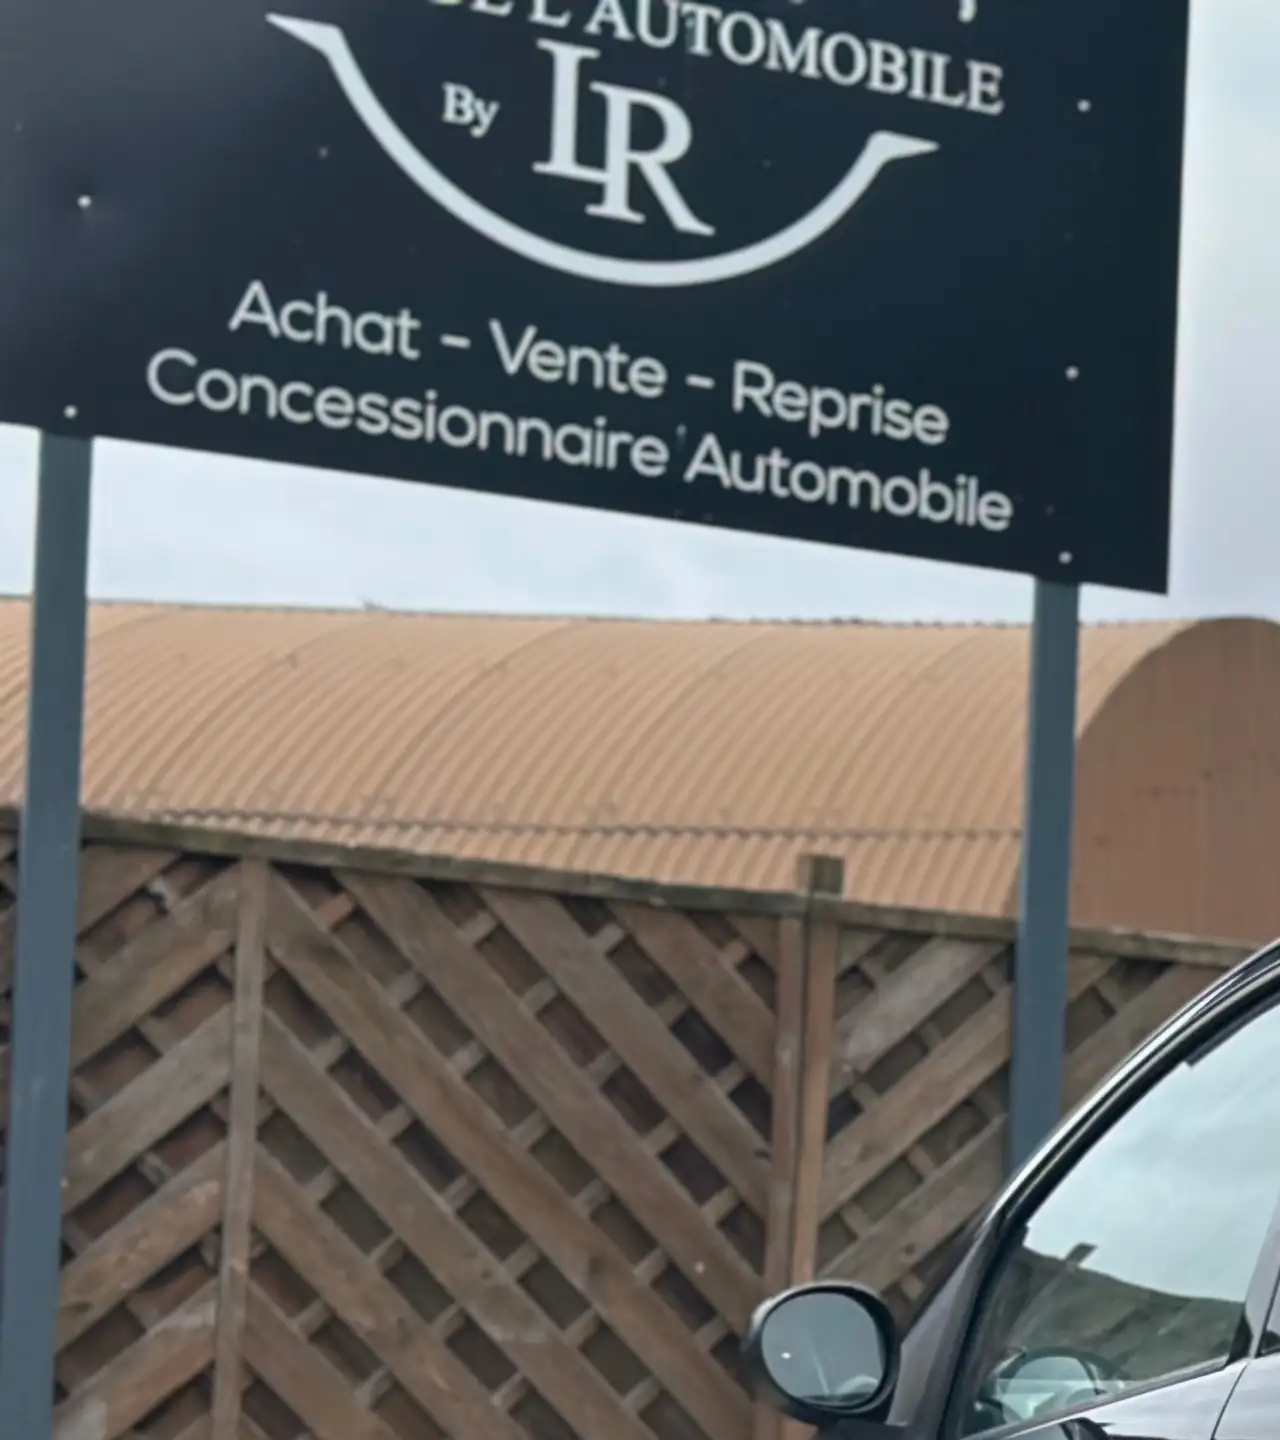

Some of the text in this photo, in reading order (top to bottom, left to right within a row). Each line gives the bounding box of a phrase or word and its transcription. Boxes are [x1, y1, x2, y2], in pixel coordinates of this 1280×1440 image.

[441, 82, 499, 137] By
[528, 0, 1004, 115] LAUTOMOBILE
[229, 280, 949, 444] Achat - Vente - Reprise
[145, 348, 1013, 530] Concessionnaire Automobile
